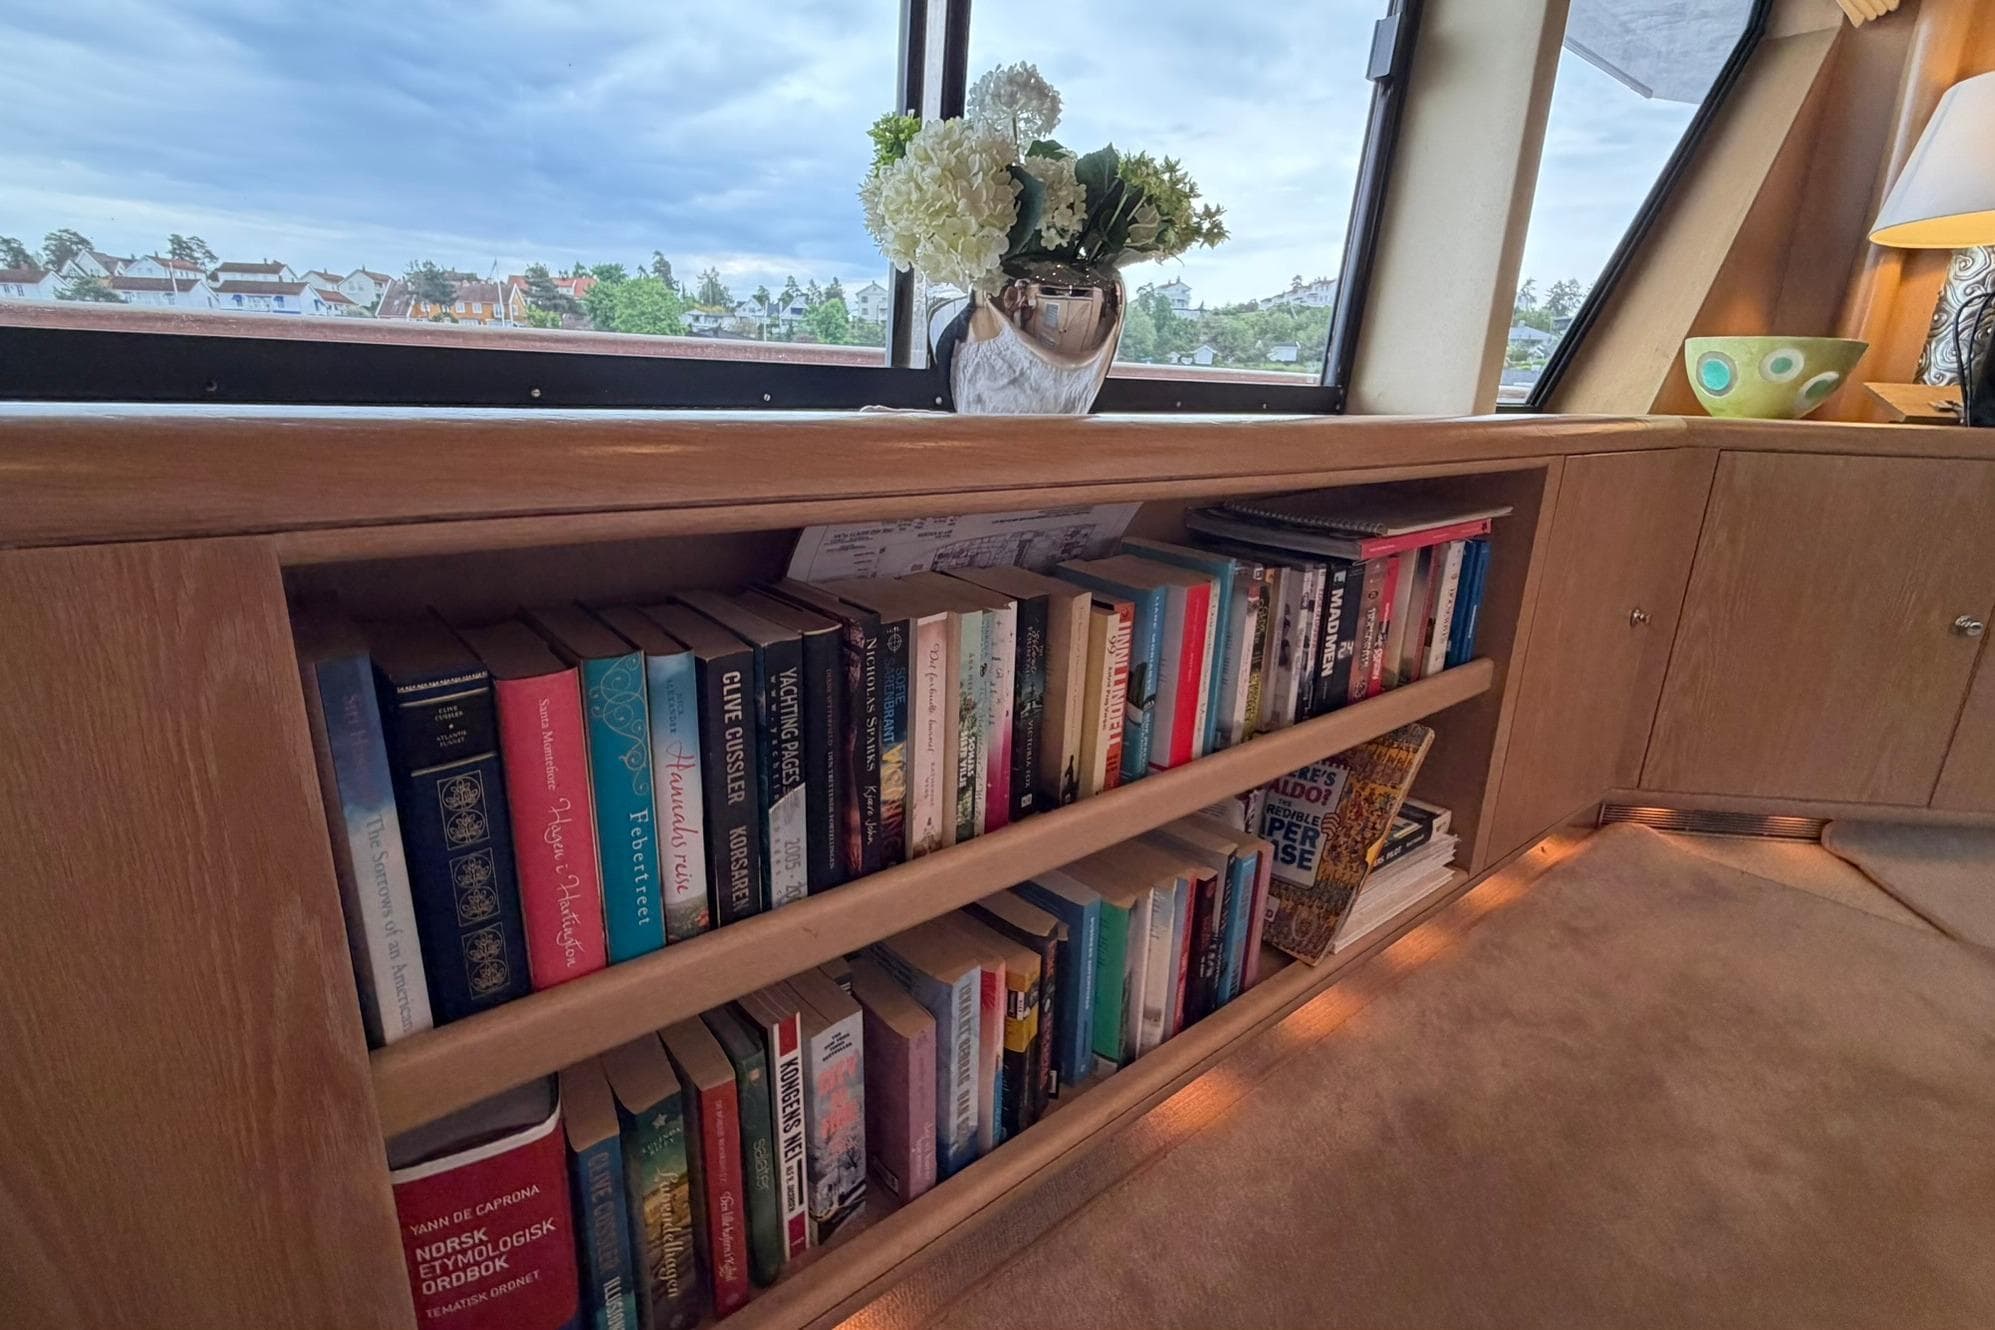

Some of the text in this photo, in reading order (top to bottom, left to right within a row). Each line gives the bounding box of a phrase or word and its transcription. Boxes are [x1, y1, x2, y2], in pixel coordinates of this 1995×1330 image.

[434, 704, 464, 721] CLIVE CUSSLER
[538, 698, 558, 792] Santa Montefiore
[779, 666, 800, 786] YACHTING PAGES
[864, 637, 877, 846] NICHOLAS SPARKS Kjære John
[882, 657, 906, 743] SOFIE SARENBRANT
[1025, 719, 1034, 767] VICTORIA
[544, 797, 572, 861] Hagen
[666, 740, 699, 893] Hannahs reise
[722, 670, 751, 913] CLIVE CUSSLER KORSAREN
[629, 808, 650, 927] Febertreet
[366, 813, 414, 1033] The Sorrows of an American
[557, 875, 585, 969] Hartington
[779, 1055, 803, 1164] KONGENS NEI
[409, 1183, 540, 1236] YANN DE CAPRONA
[588, 1151, 612, 1201] CLIVE
[415, 1227, 489, 1262] NORSK
[419, 1216, 557, 1280] ETYMOLOGISK
[422, 1255, 510, 1296] ORDBOK
[654, 1167, 685, 1298] Lavendelhagen
[426, 1269, 542, 1319] TEMATISK ORDNET
